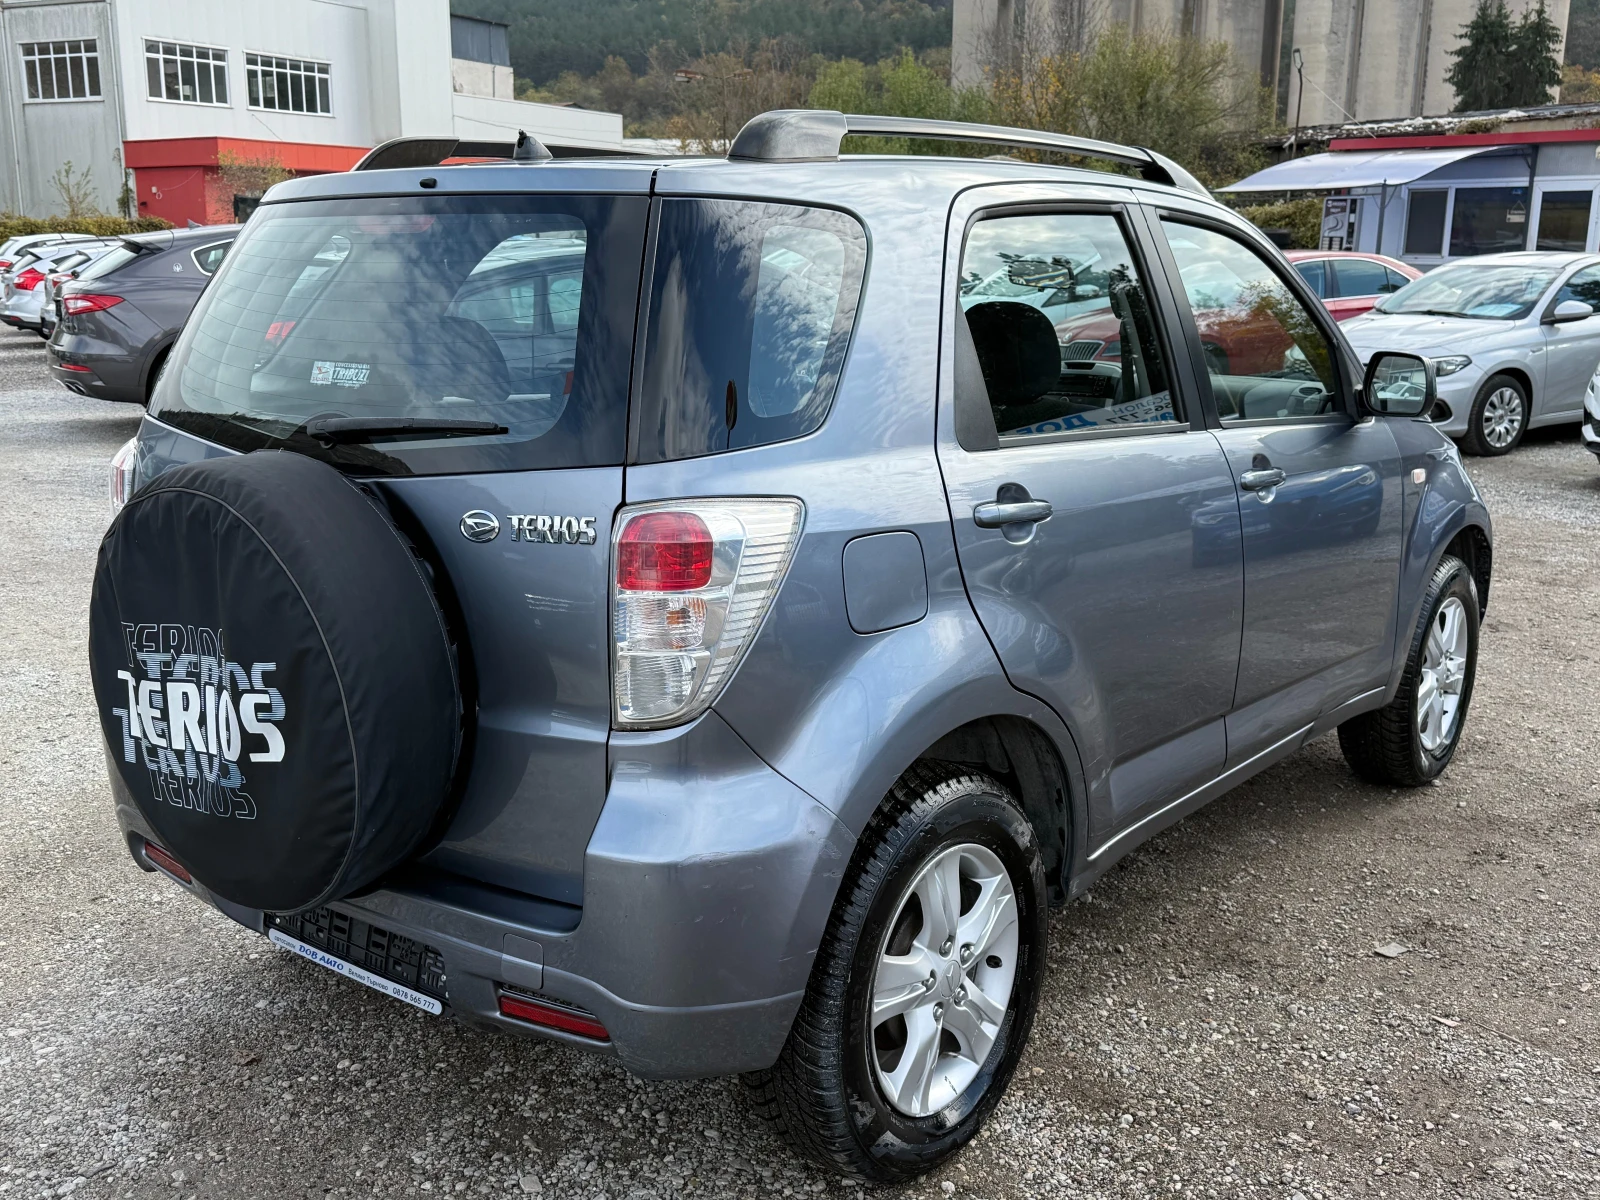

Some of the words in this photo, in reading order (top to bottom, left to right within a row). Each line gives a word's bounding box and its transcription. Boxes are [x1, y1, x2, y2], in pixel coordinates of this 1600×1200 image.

[507, 514, 597, 545] TERIOS
[120, 621, 225, 672] TERIO
[117, 669, 287, 763] TERIOS
[298, 944, 318, 960] DOB
[319, 955, 345, 971] AUTO
[348, 967, 366, 982] Велико
[366, 976, 389, 991] Търново
[392, 987, 409, 1000] 0878
[409, 993, 422, 1005] 565
[423, 999, 435, 1010] 777
